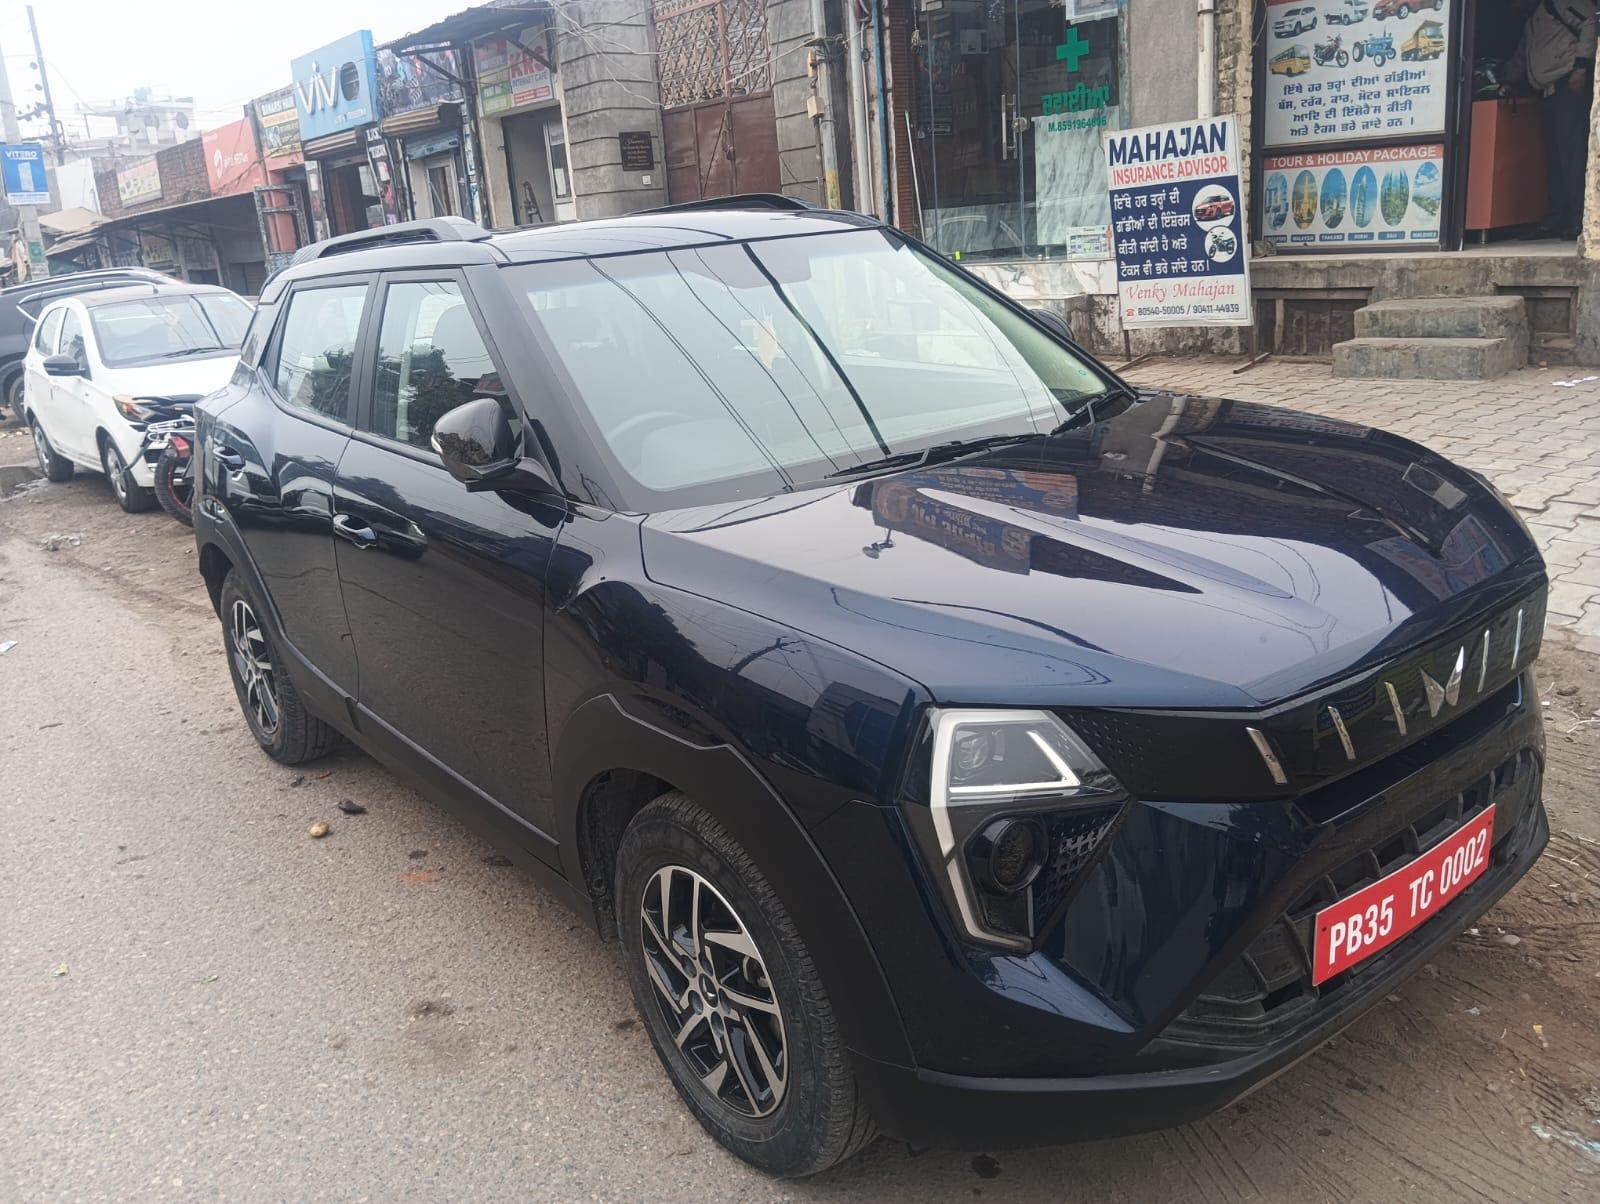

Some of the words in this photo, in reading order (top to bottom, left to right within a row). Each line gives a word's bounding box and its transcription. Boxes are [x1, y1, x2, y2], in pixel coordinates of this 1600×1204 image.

[1307, 83, 1322, 92] ਹਰ
[1324, 107, 1337, 119] ਦੀ
[1109, 121, 1227, 166] MAHAJAN
[1272, 155, 1303, 168] TOUR
[1305, 155, 1314, 166] &
[1317, 151, 1371, 165] HOLIDAY
[1373, 146, 1437, 160] PACKAGE
[1112, 162, 1174, 186] INSURANCE
[1177, 155, 1228, 178] ADVISOR
[1134, 195, 1147, 208] ਹਰ
[1169, 187, 1180, 204] ਦੀ
[1147, 213, 1158, 230] ਦੀ
[1117, 239, 1137, 255] ਕੀਤੀ
[1161, 234, 1169, 251] ਹੈ
[1171, 233, 1187, 250] ਅਤੇ
[1120, 260, 1140, 277] ਟੈਕਸ
[1143, 259, 1153, 275] ਵੀ
[1155, 257, 1168, 274] ਭਰੇ
[1126, 282, 1168, 303] Venky
[1173, 280, 1235, 301] Mahajan
[1138, 305, 1185, 316] 80540-50005
[1193, 303, 1240, 314] 90411-44939
[1328, 894, 1395, 966] PB35
[1409, 869, 1434, 918] TC
[1439, 828, 1488, 895] 0002
